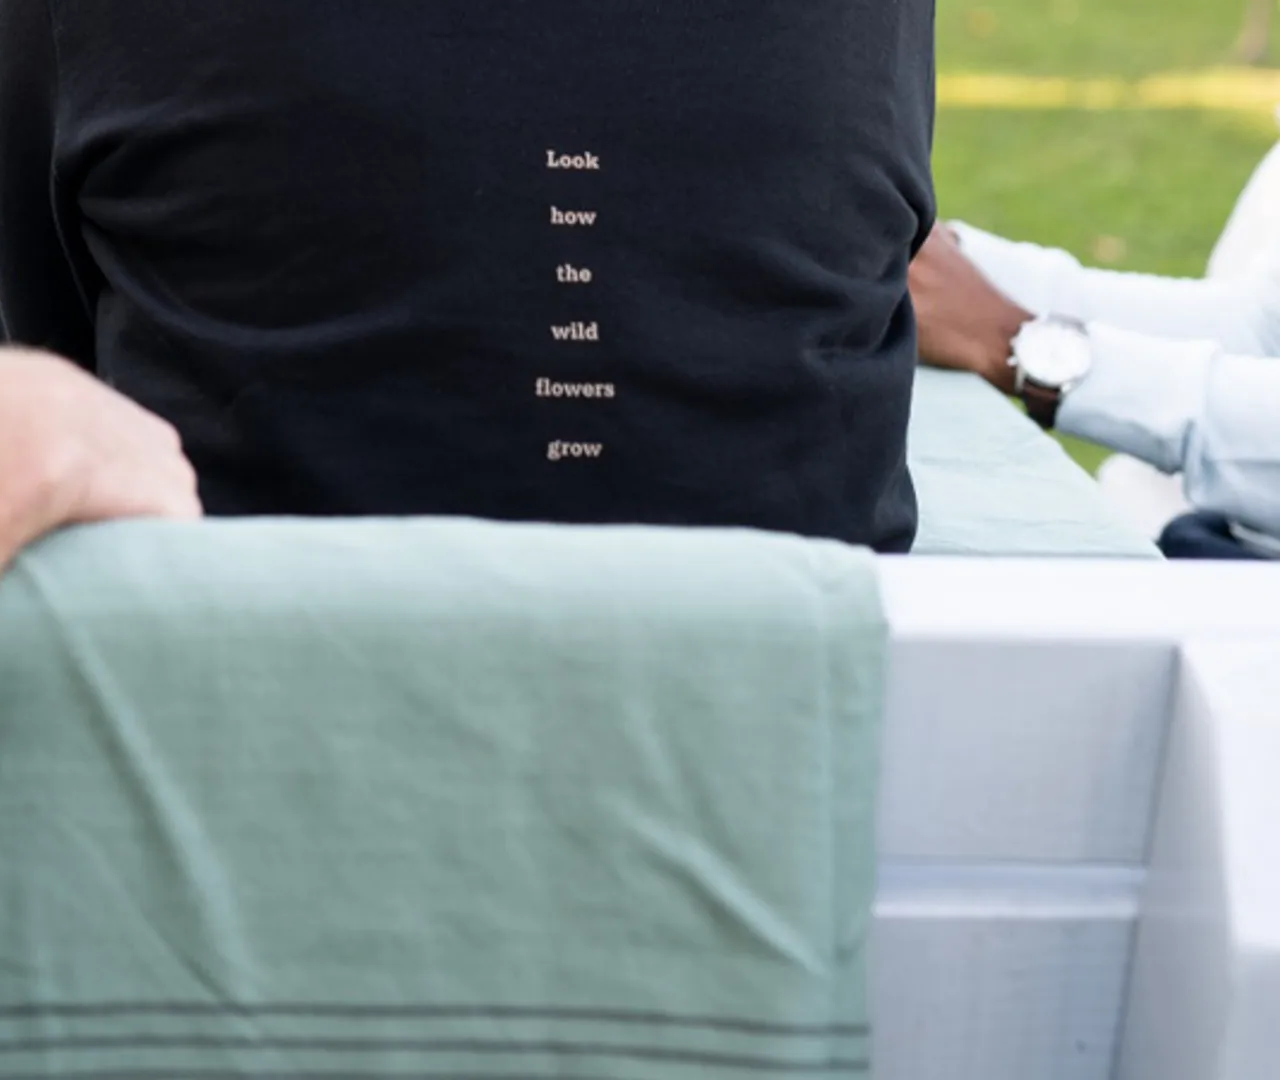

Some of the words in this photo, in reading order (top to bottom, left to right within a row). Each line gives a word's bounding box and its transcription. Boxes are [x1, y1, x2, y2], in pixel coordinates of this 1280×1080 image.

[546, 150, 600, 169] Look
[550, 206, 597, 225] how
[556, 263, 592, 283] the
[550, 321, 599, 341] wild
[535, 377, 615, 398] flowers
[547, 440, 602, 460] grow
